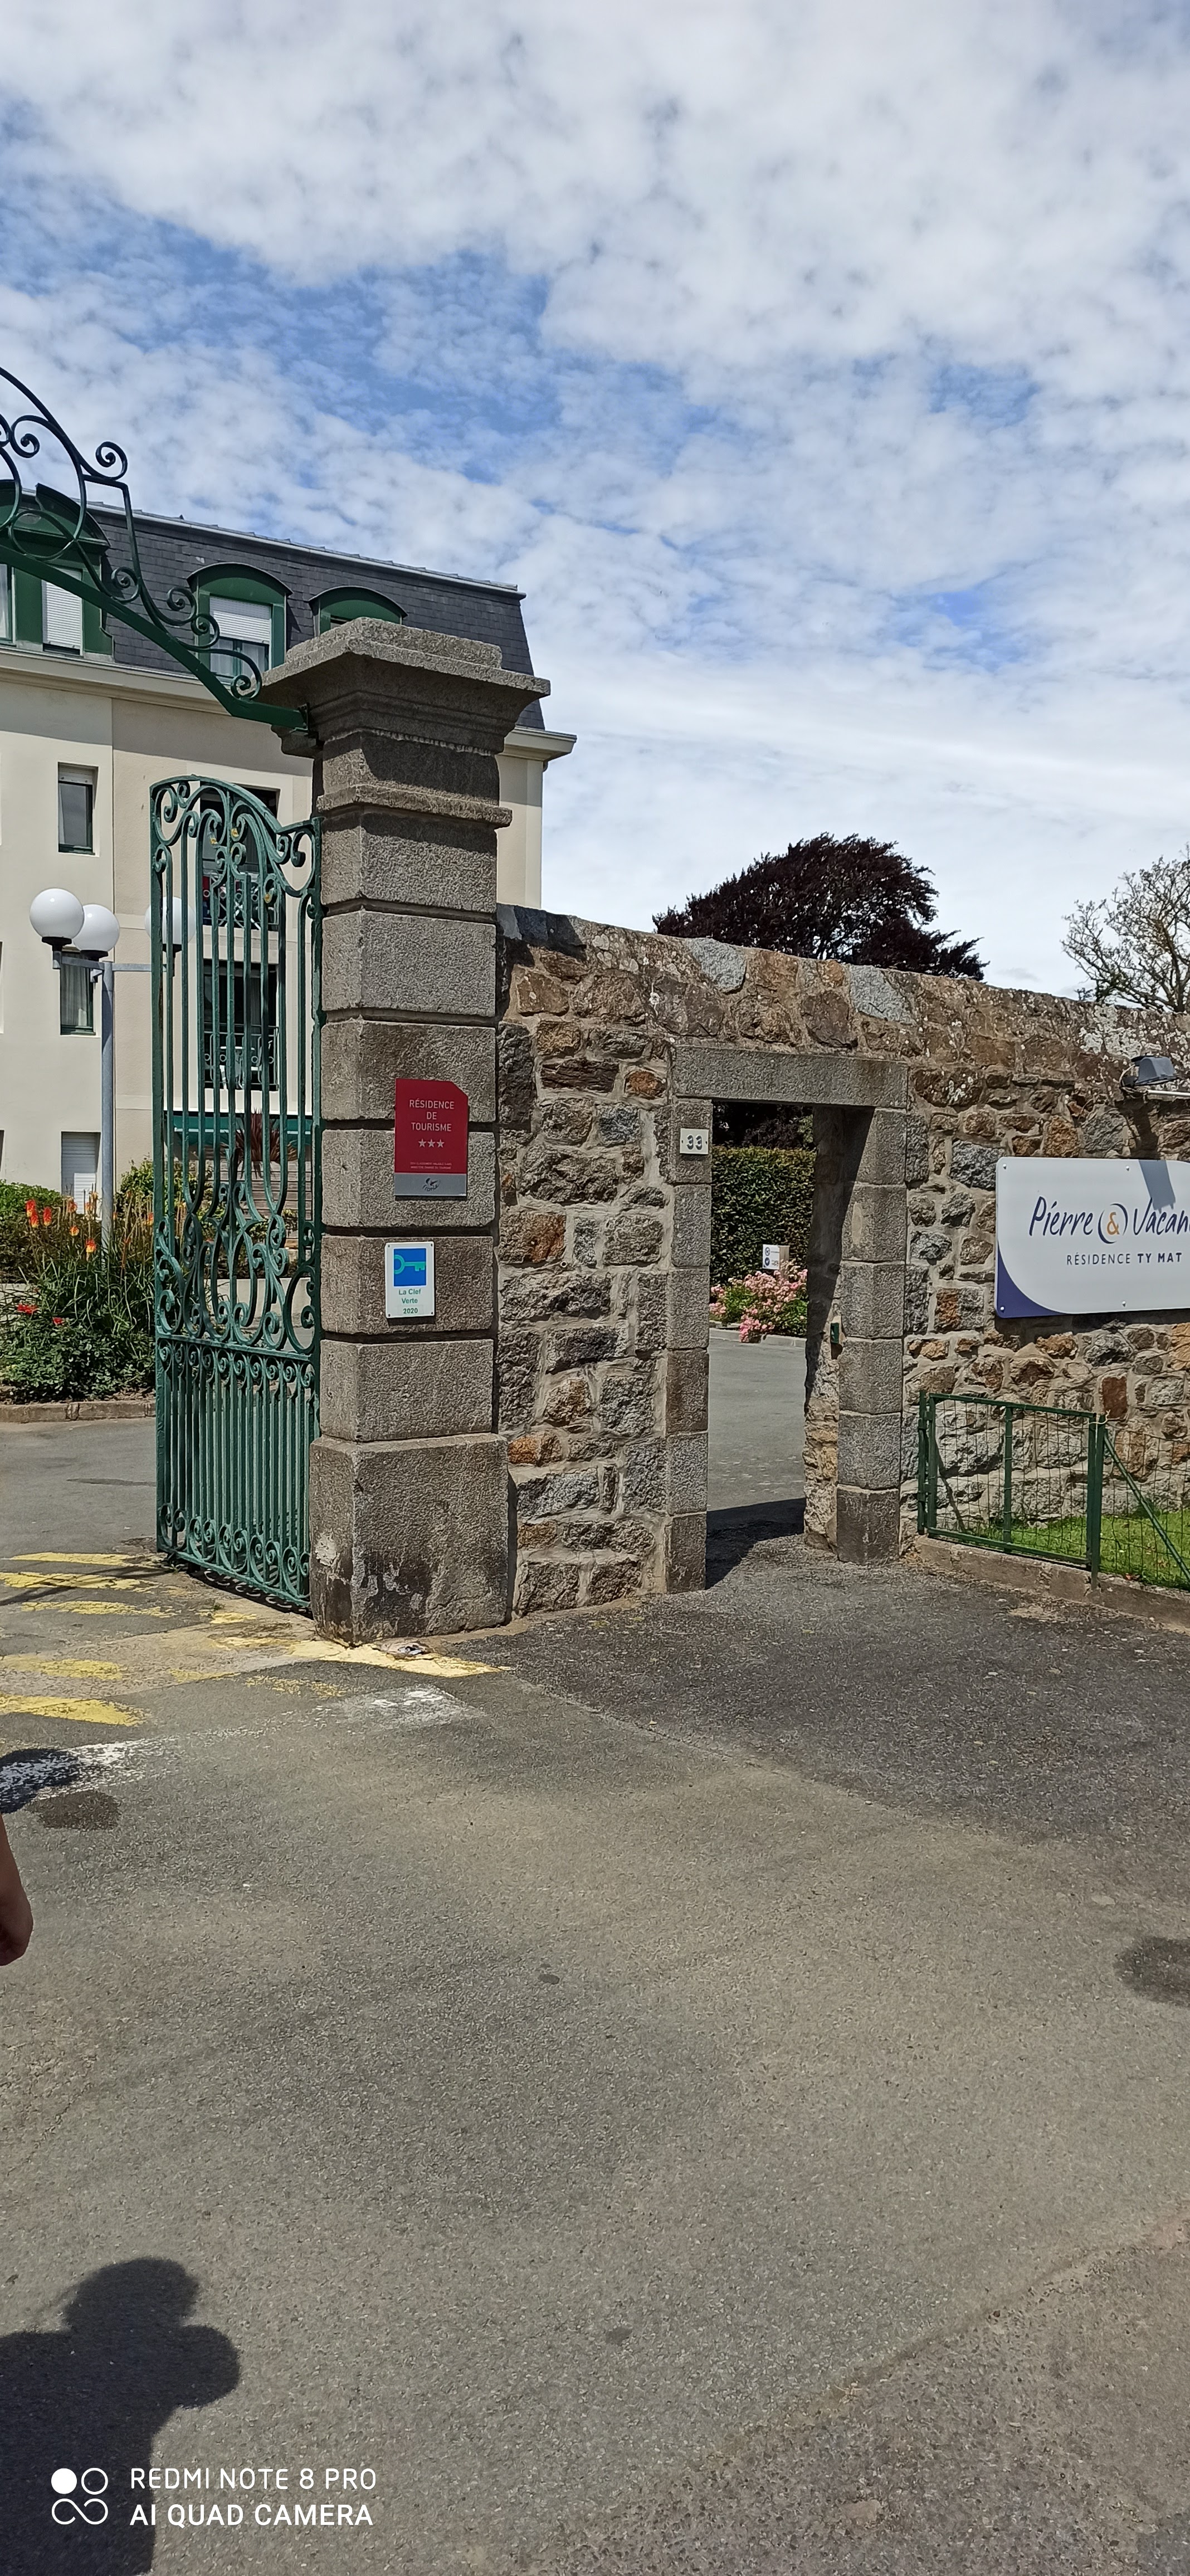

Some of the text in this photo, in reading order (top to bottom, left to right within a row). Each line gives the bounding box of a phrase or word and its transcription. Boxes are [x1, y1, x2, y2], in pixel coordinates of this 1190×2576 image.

[409, 1098, 455, 1109] RÉSIDENCE
[426, 1111, 437, 1120] DE
[411, 1123, 452, 1132] TOURISME
[686, 1135, 702, 1150] 33
[1029, 1196, 1093, 1236] Pierre
[1133, 1197, 1190, 1236] Vacan
[1067, 1252, 1182, 1265] RÉSIDENCE TY MAT
